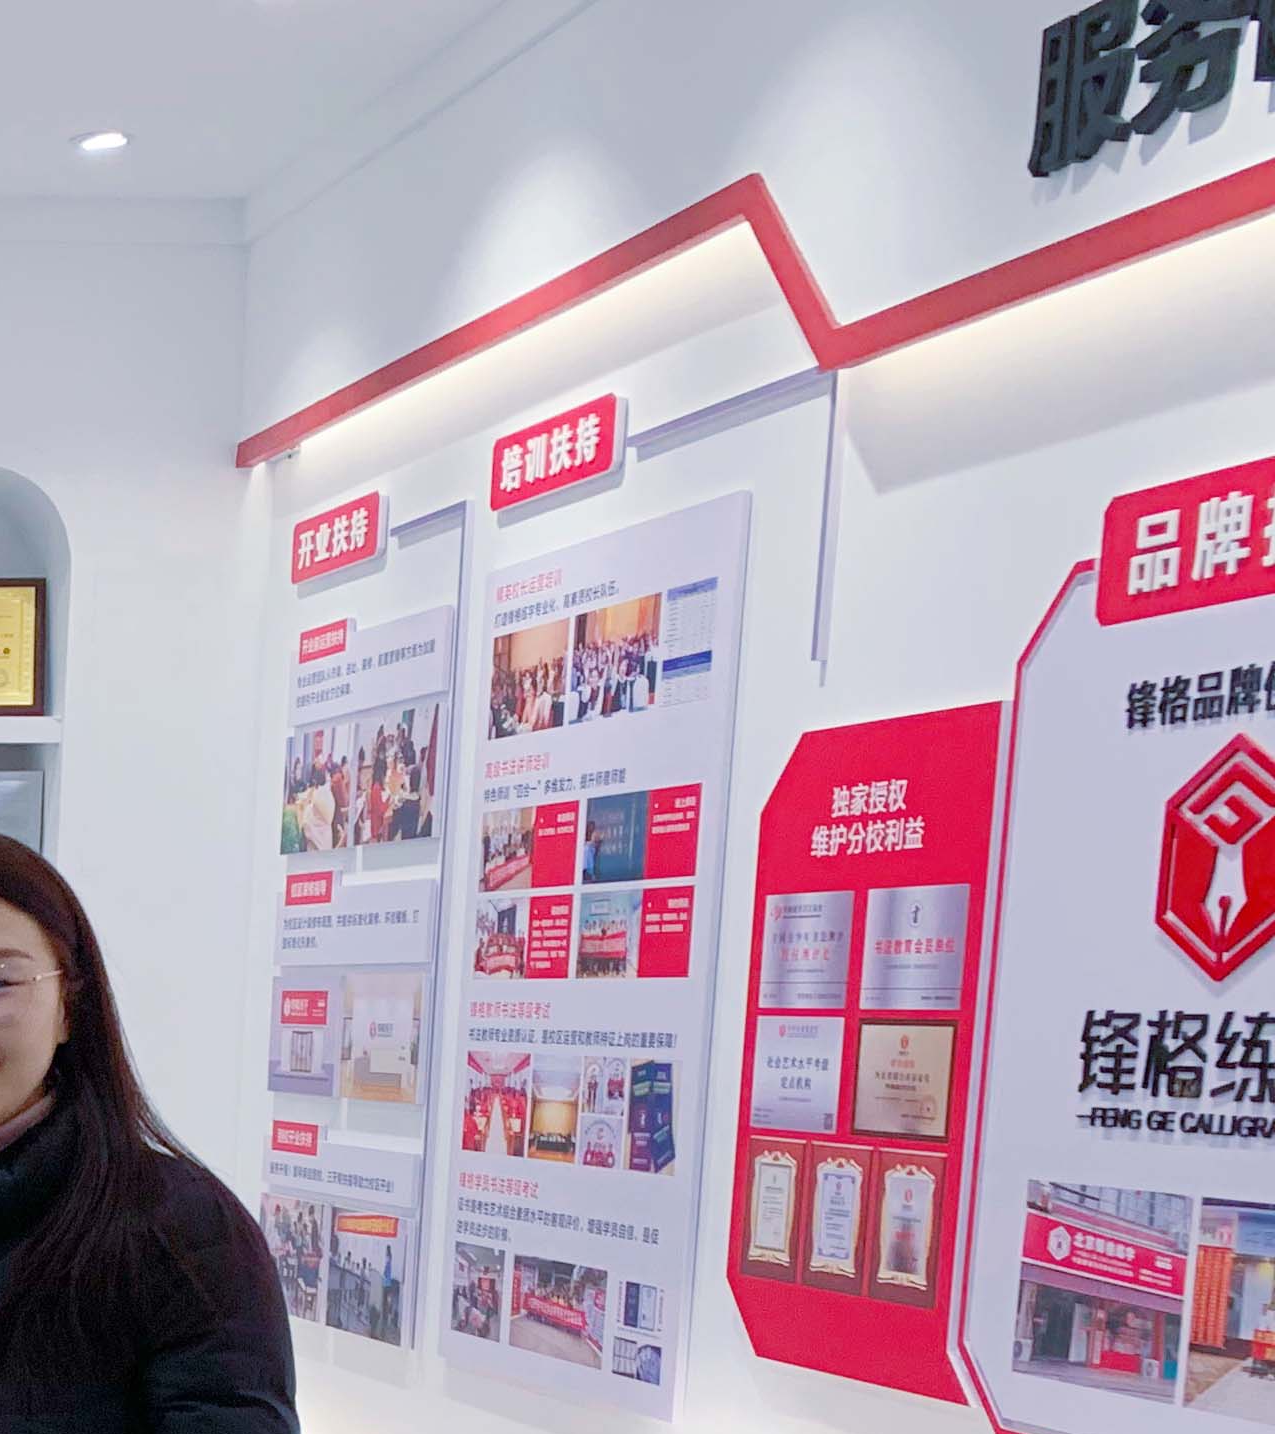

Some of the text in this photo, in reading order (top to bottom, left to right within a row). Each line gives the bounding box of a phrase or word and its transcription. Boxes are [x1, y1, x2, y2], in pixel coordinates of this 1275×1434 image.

[1028, 0, 1275, 177] 服务
[501, 412, 602, 493] 培训扶持
[297, 509, 369, 571] 开业扶持
[831, 779, 908, 819] 独家授权
[810, 816, 926, 858] 维护分校利益
